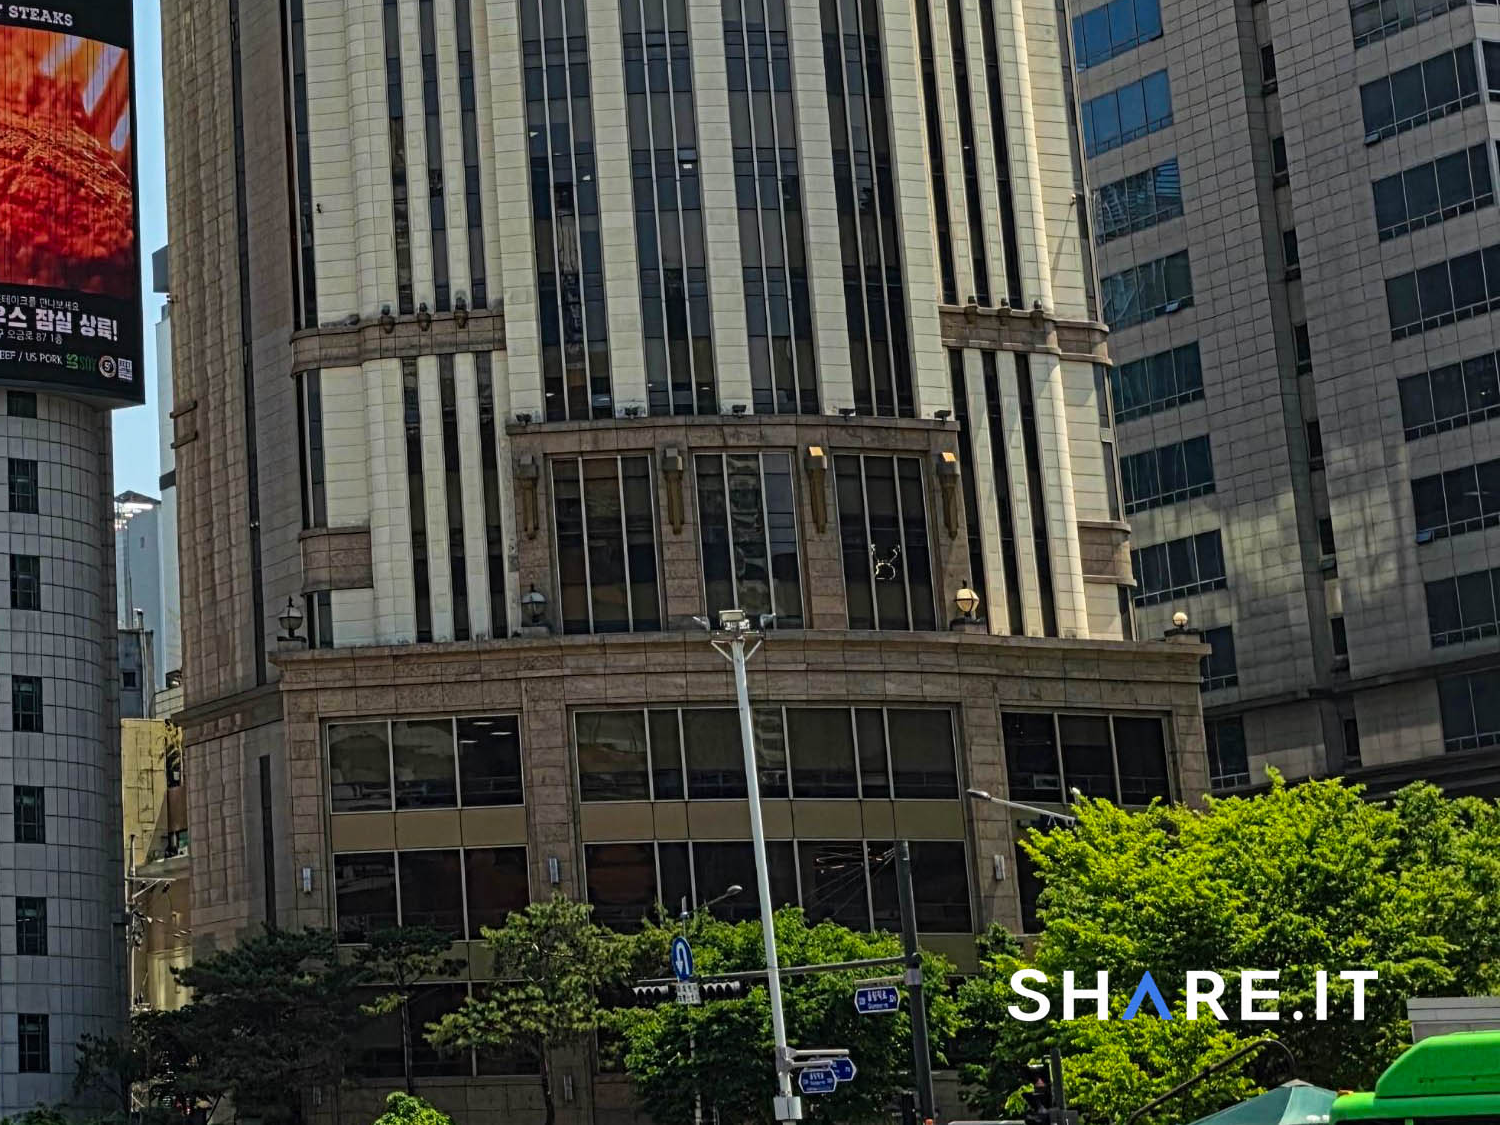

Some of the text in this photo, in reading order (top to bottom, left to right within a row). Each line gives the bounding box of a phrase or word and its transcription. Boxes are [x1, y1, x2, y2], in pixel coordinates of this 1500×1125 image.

[9, 5, 74, 26] STEAKS
[35, 308, 73, 334] 잠실
[80, 314, 118, 341] 상륙!
[7, 329, 34, 341] 오금로
[36, 332, 47, 342] 87
[25, 352, 38, 362] US
[39, 354, 63, 365] PORK
